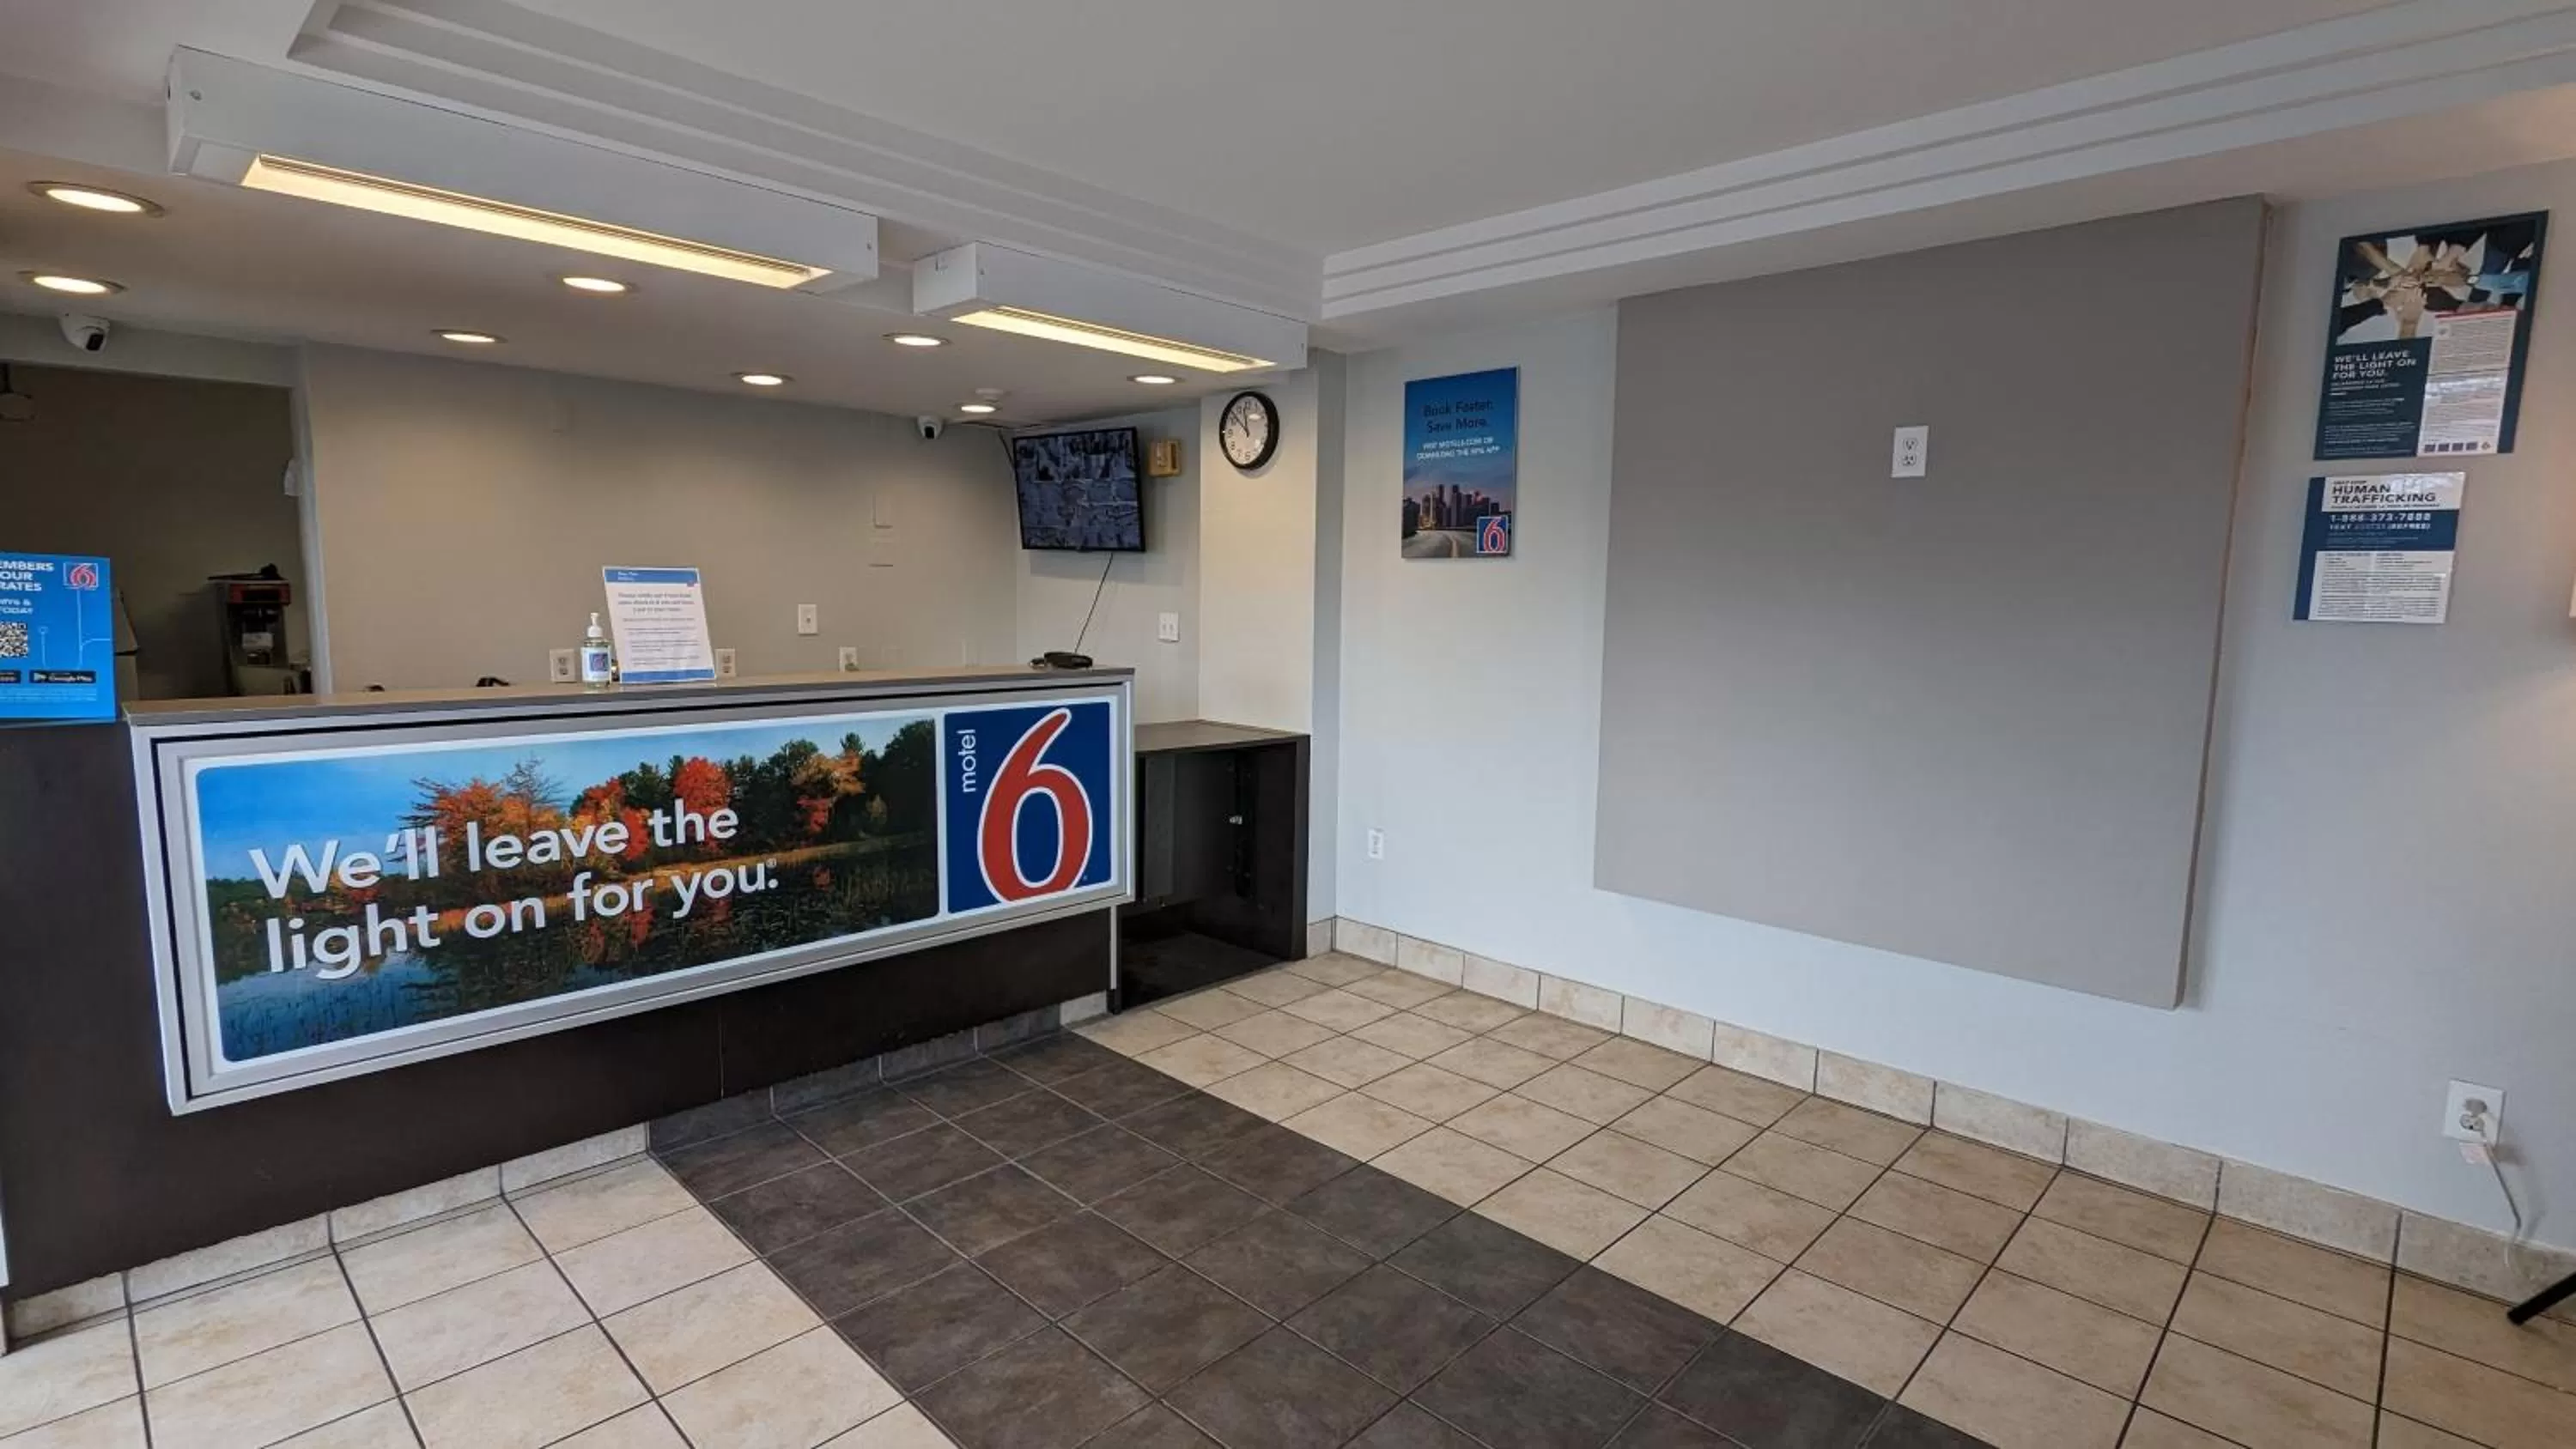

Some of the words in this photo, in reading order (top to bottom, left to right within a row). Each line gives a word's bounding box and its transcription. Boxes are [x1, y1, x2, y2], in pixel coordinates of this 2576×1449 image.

[2359, 360, 2394, 370] LIGHT
[2397, 358, 2416, 367] ON
[2331, 493, 2436, 504] TRAFFICKING
[2332, 484, 2391, 494] HUMAN
[1483, 516, 1505, 552] 6
[957, 729, 976, 793] motel
[977, 707, 1093, 904] 6
[247, 825, 440, 899] We'll
[466, 821, 630, 872] leave
[648, 797, 738, 847] the
[266, 903, 440, 980] light
[465, 896, 545, 938] on
[567, 870, 654, 921] for
